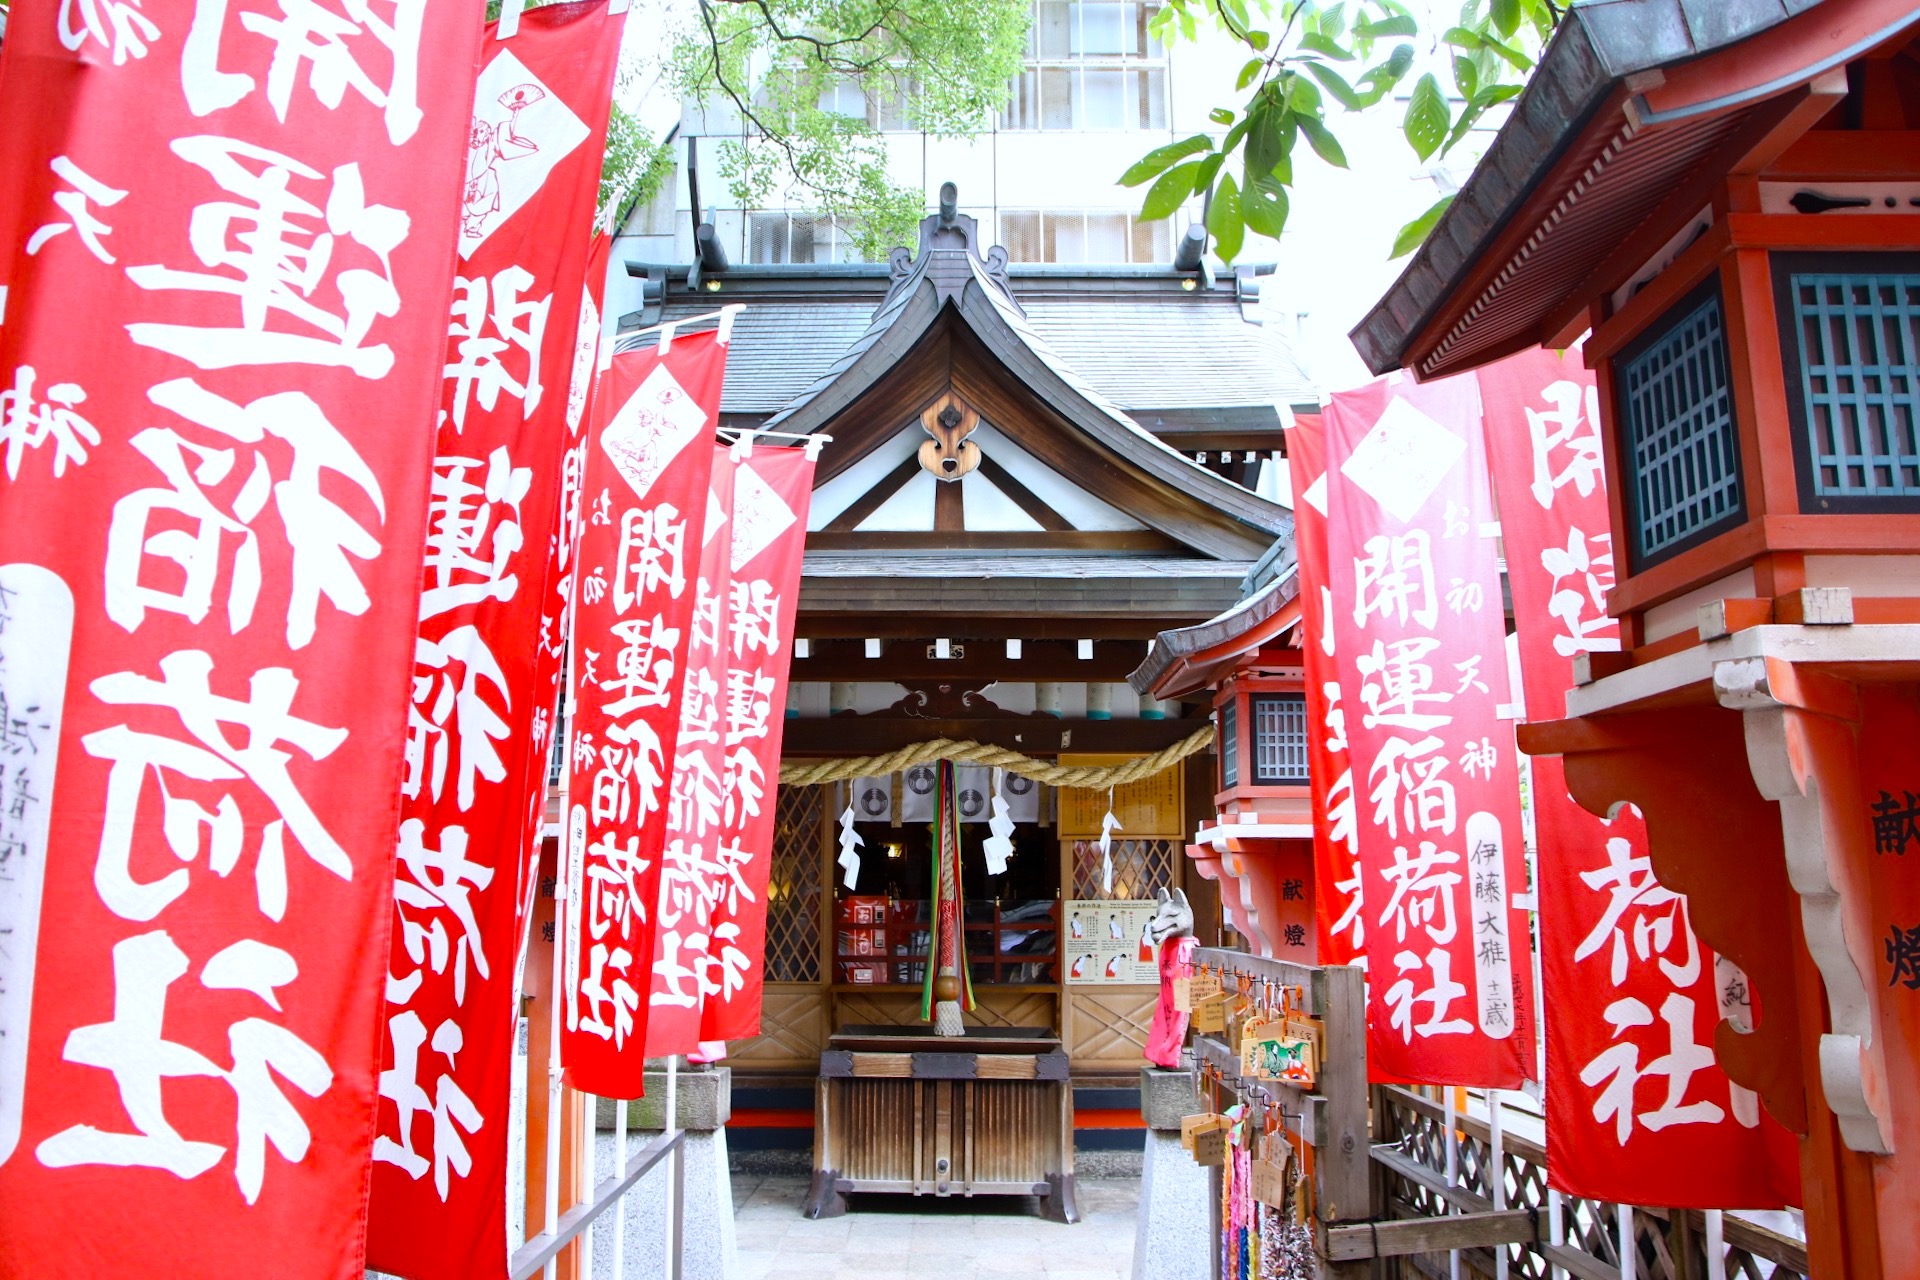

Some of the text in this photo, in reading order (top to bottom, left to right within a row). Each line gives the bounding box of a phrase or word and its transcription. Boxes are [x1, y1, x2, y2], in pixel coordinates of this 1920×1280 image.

[1443, 499, 1498, 781] お初天神
[1281, 878, 1306, 947] 献燈
[1353, 528, 1474, 1046] 開運稲荷社
